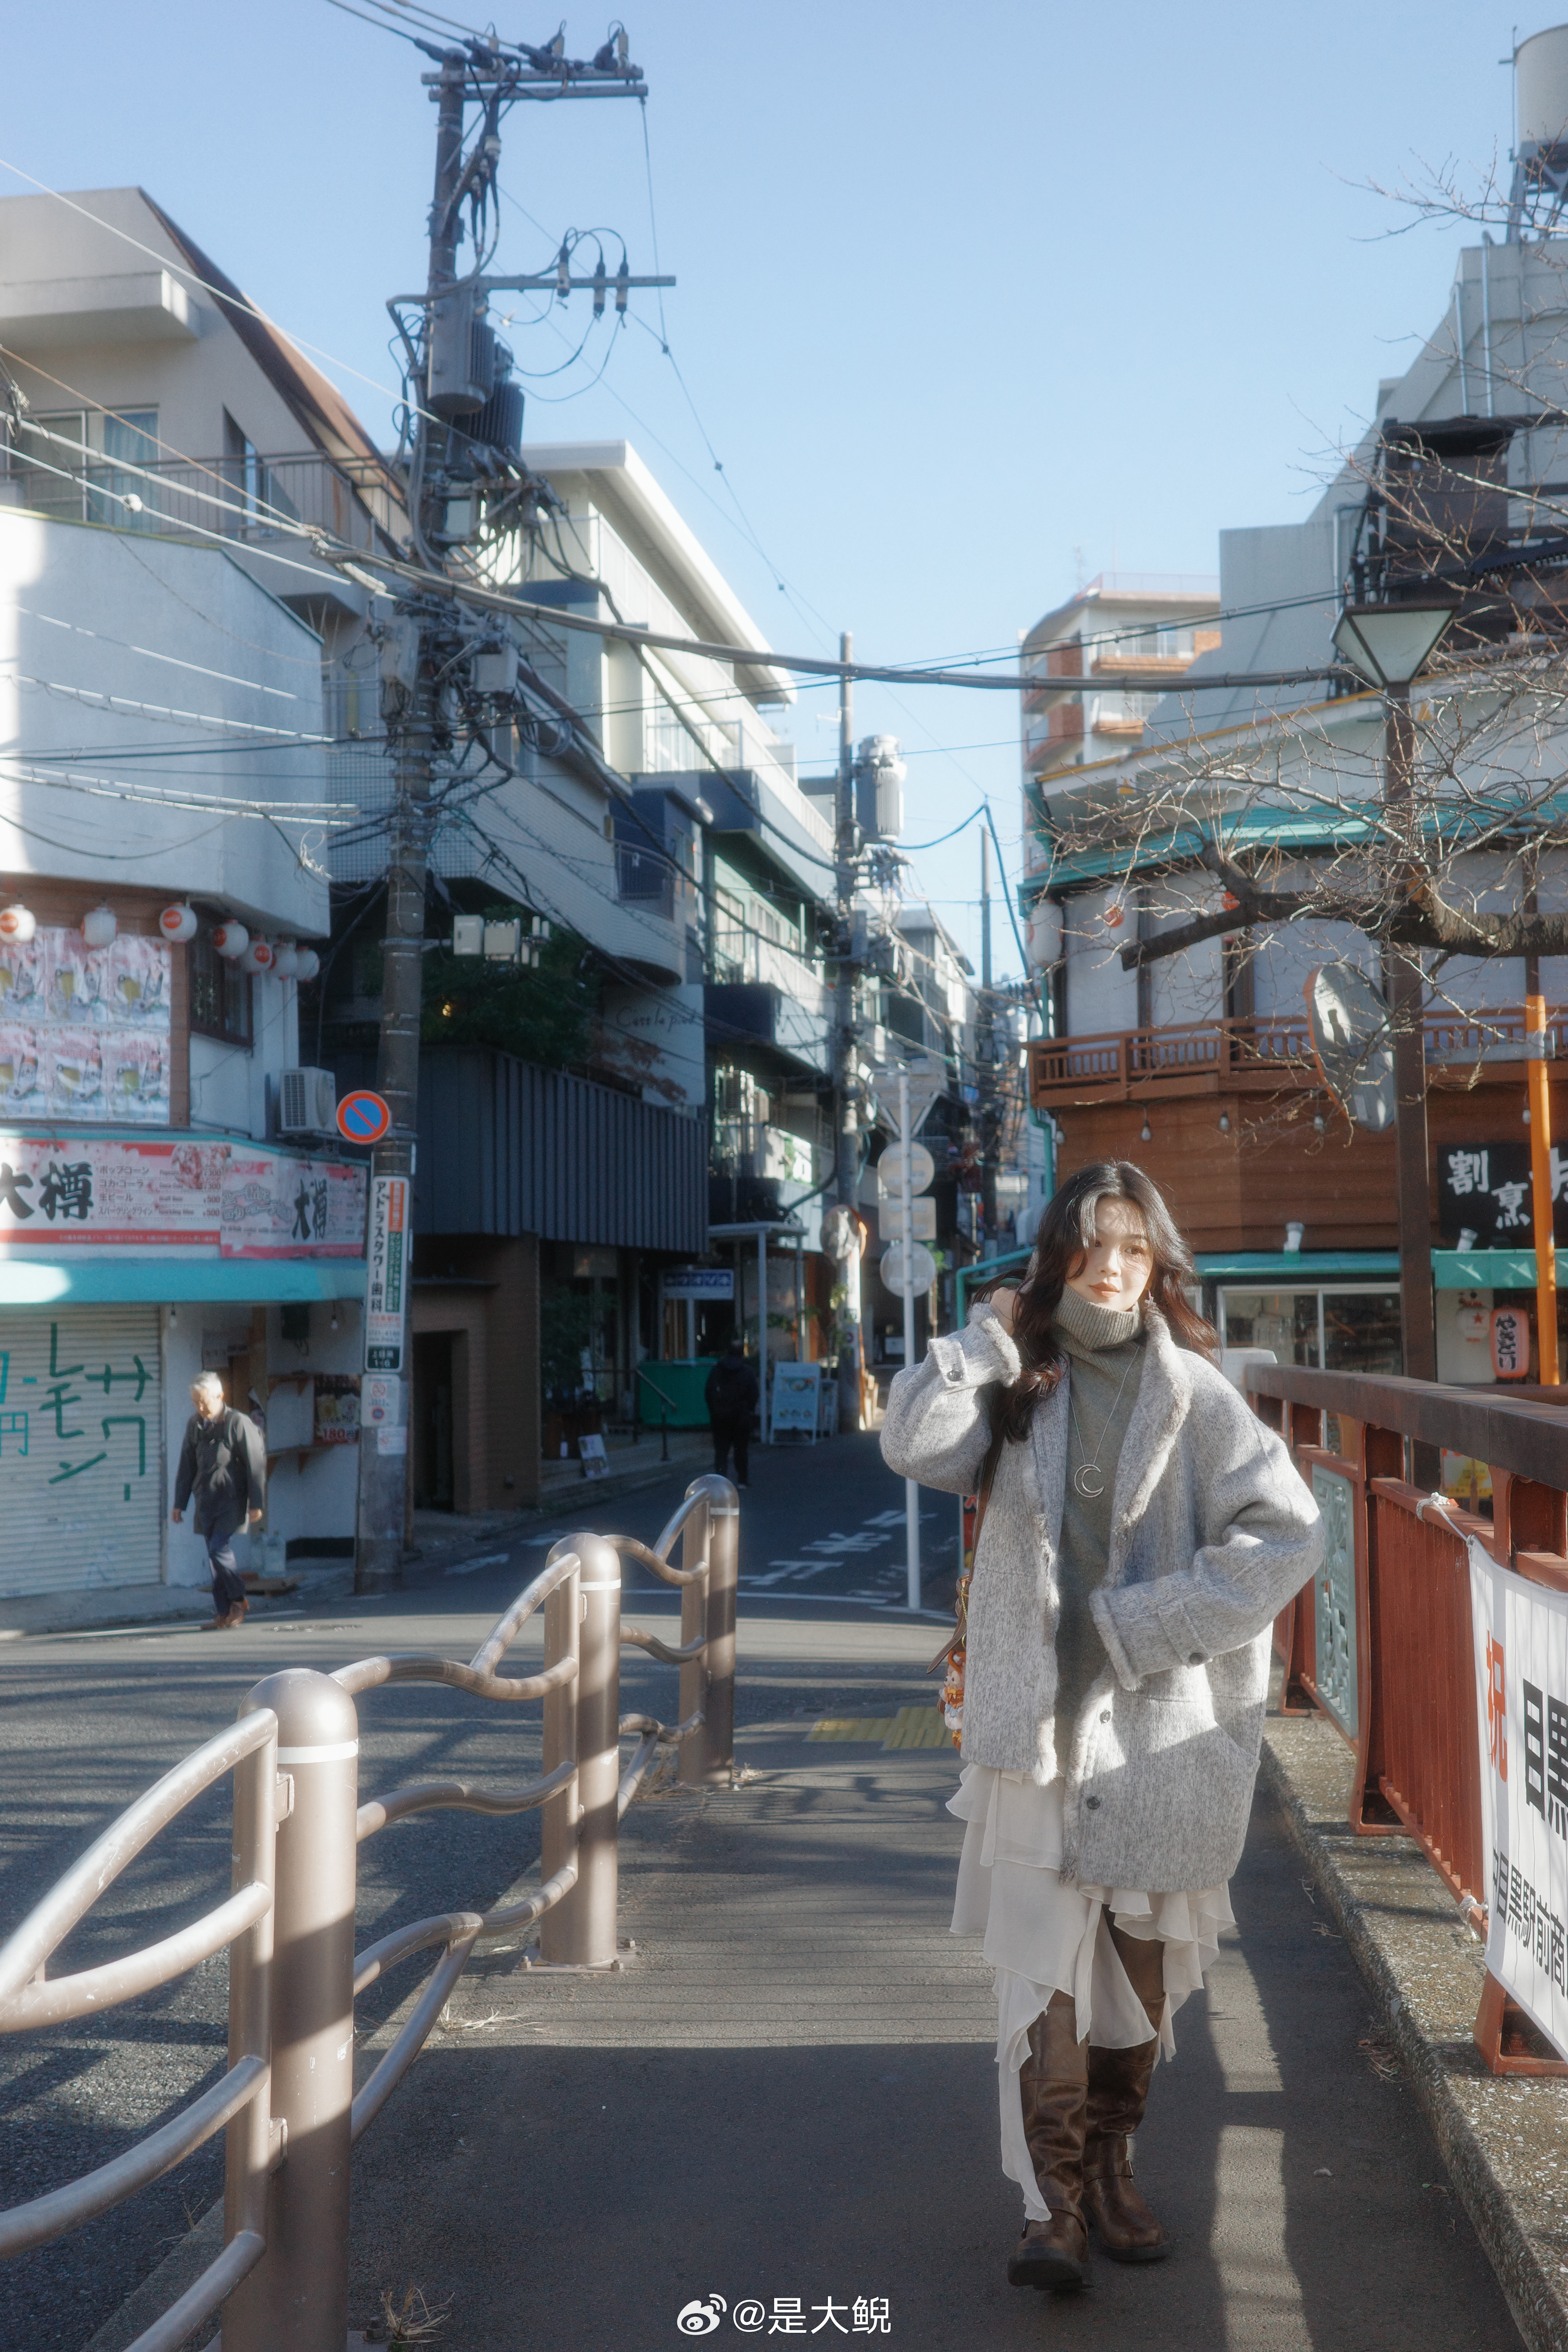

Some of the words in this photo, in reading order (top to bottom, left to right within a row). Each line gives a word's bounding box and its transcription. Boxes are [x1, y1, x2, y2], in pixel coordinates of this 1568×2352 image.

[0, 1161, 94, 1221] 大樽
[99, 1192, 134, 1202] 生ビール
[1495, 1315, 1517, 1370] やきとり
[1493, 1846, 1568, 1998] 中目黒駅前商
